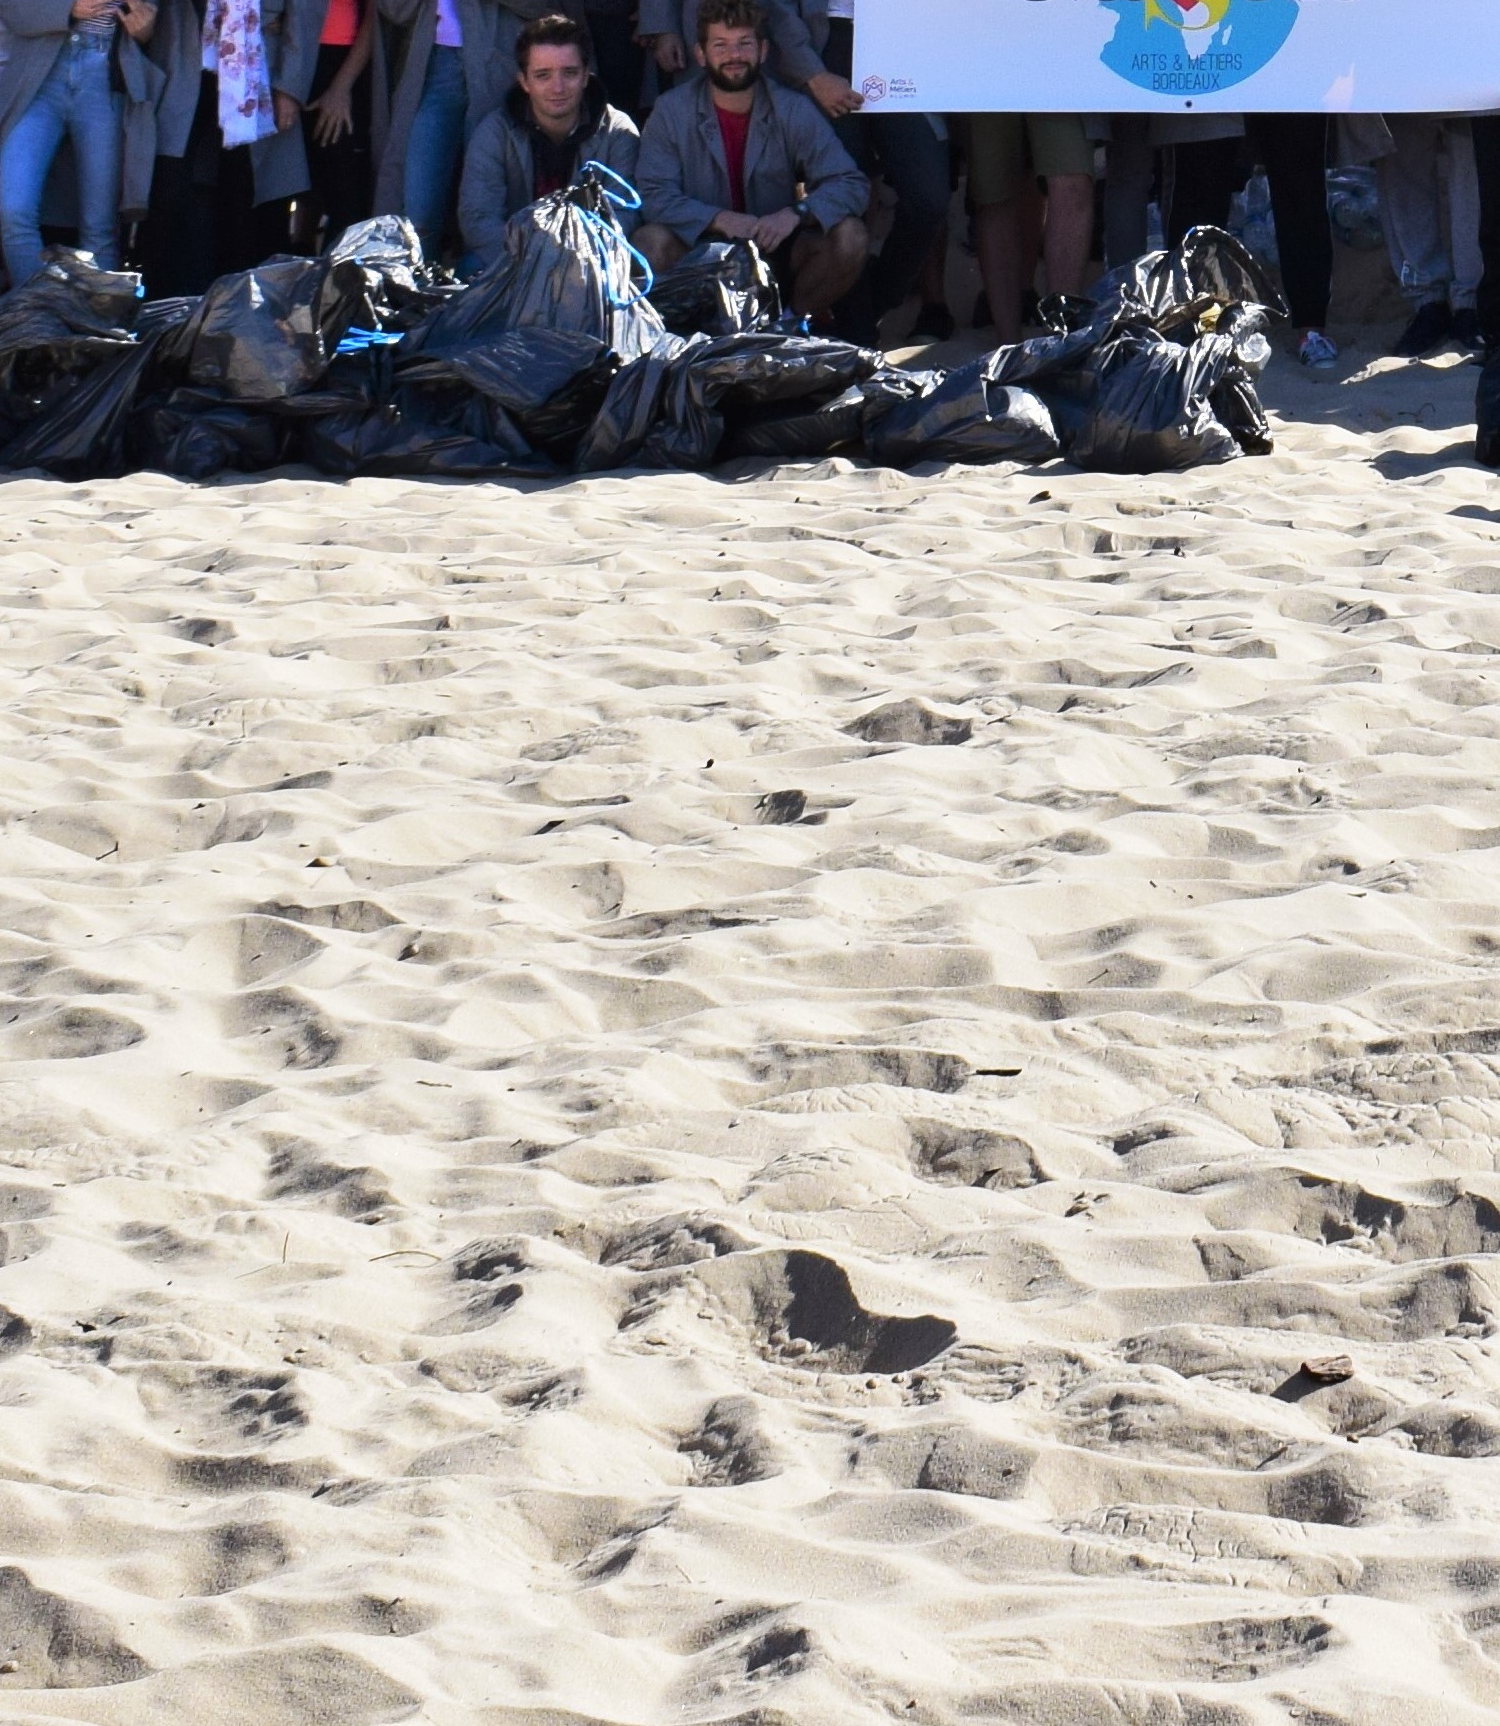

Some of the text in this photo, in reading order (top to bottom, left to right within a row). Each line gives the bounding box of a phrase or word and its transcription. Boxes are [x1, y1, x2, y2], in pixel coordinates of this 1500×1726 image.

[1132, 53, 1167, 71] ARTS
[1173, 54, 1182, 71] &
[1153, 72, 1220, 90] BORDEAUX
